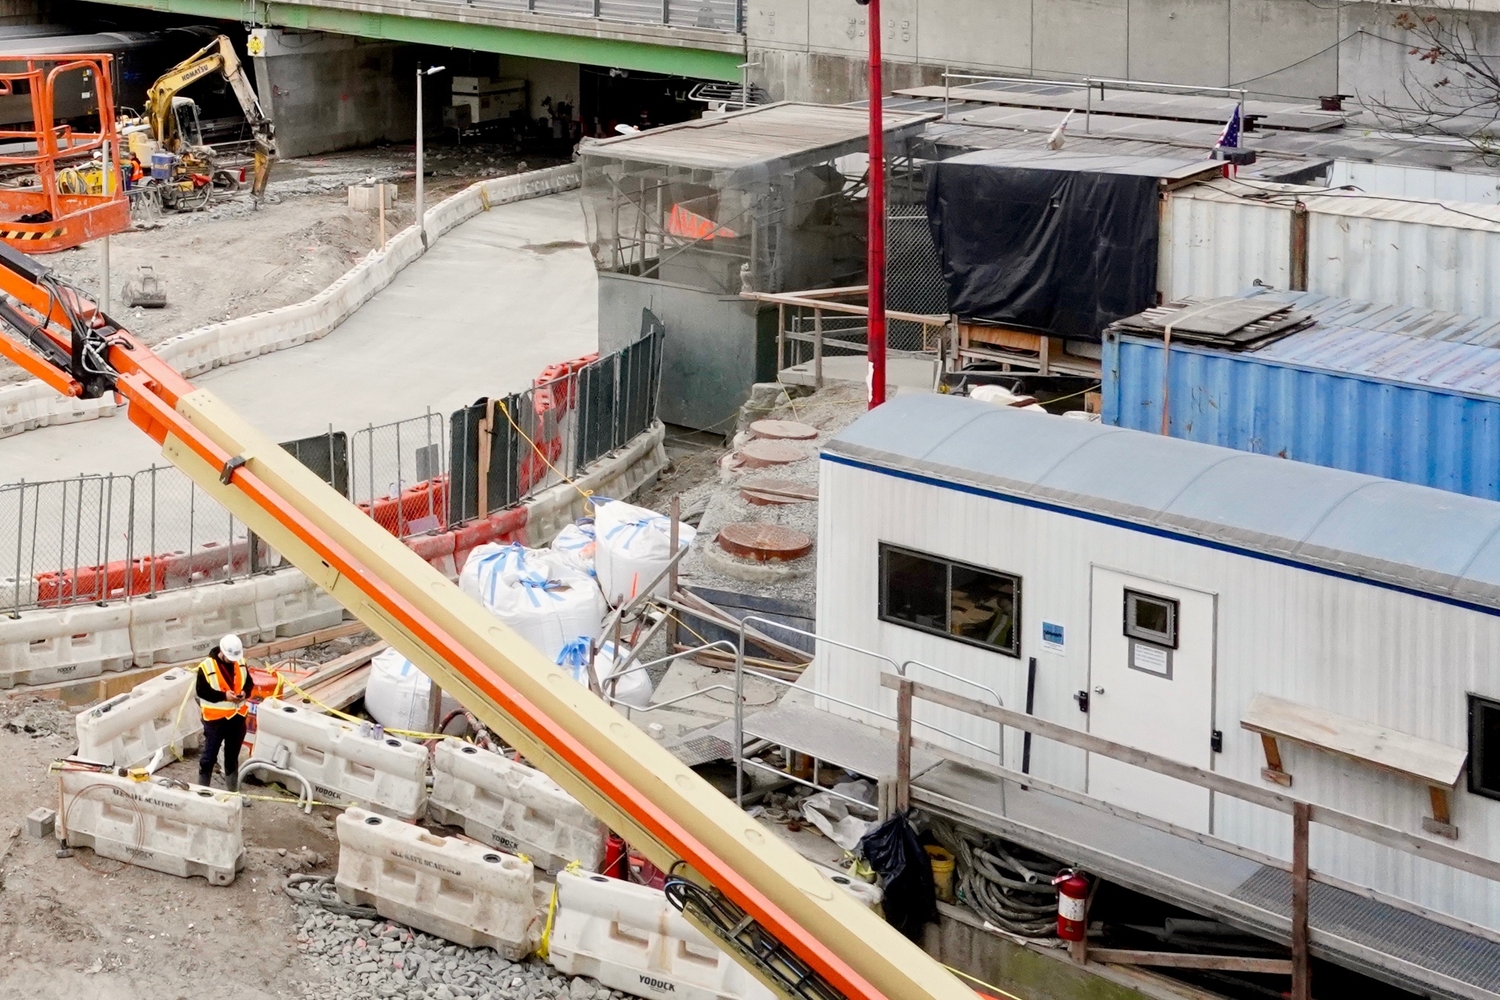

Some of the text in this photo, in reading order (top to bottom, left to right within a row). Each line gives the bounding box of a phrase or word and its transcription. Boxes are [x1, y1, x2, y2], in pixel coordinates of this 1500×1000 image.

[182, 65, 209, 81] KOMATSU
[57, 665, 76, 673] YODOCK
[315, 785, 341, 799] YODOCK
[492, 834, 518, 849] YODOCK
[639, 975, 675, 992] YODOCK
